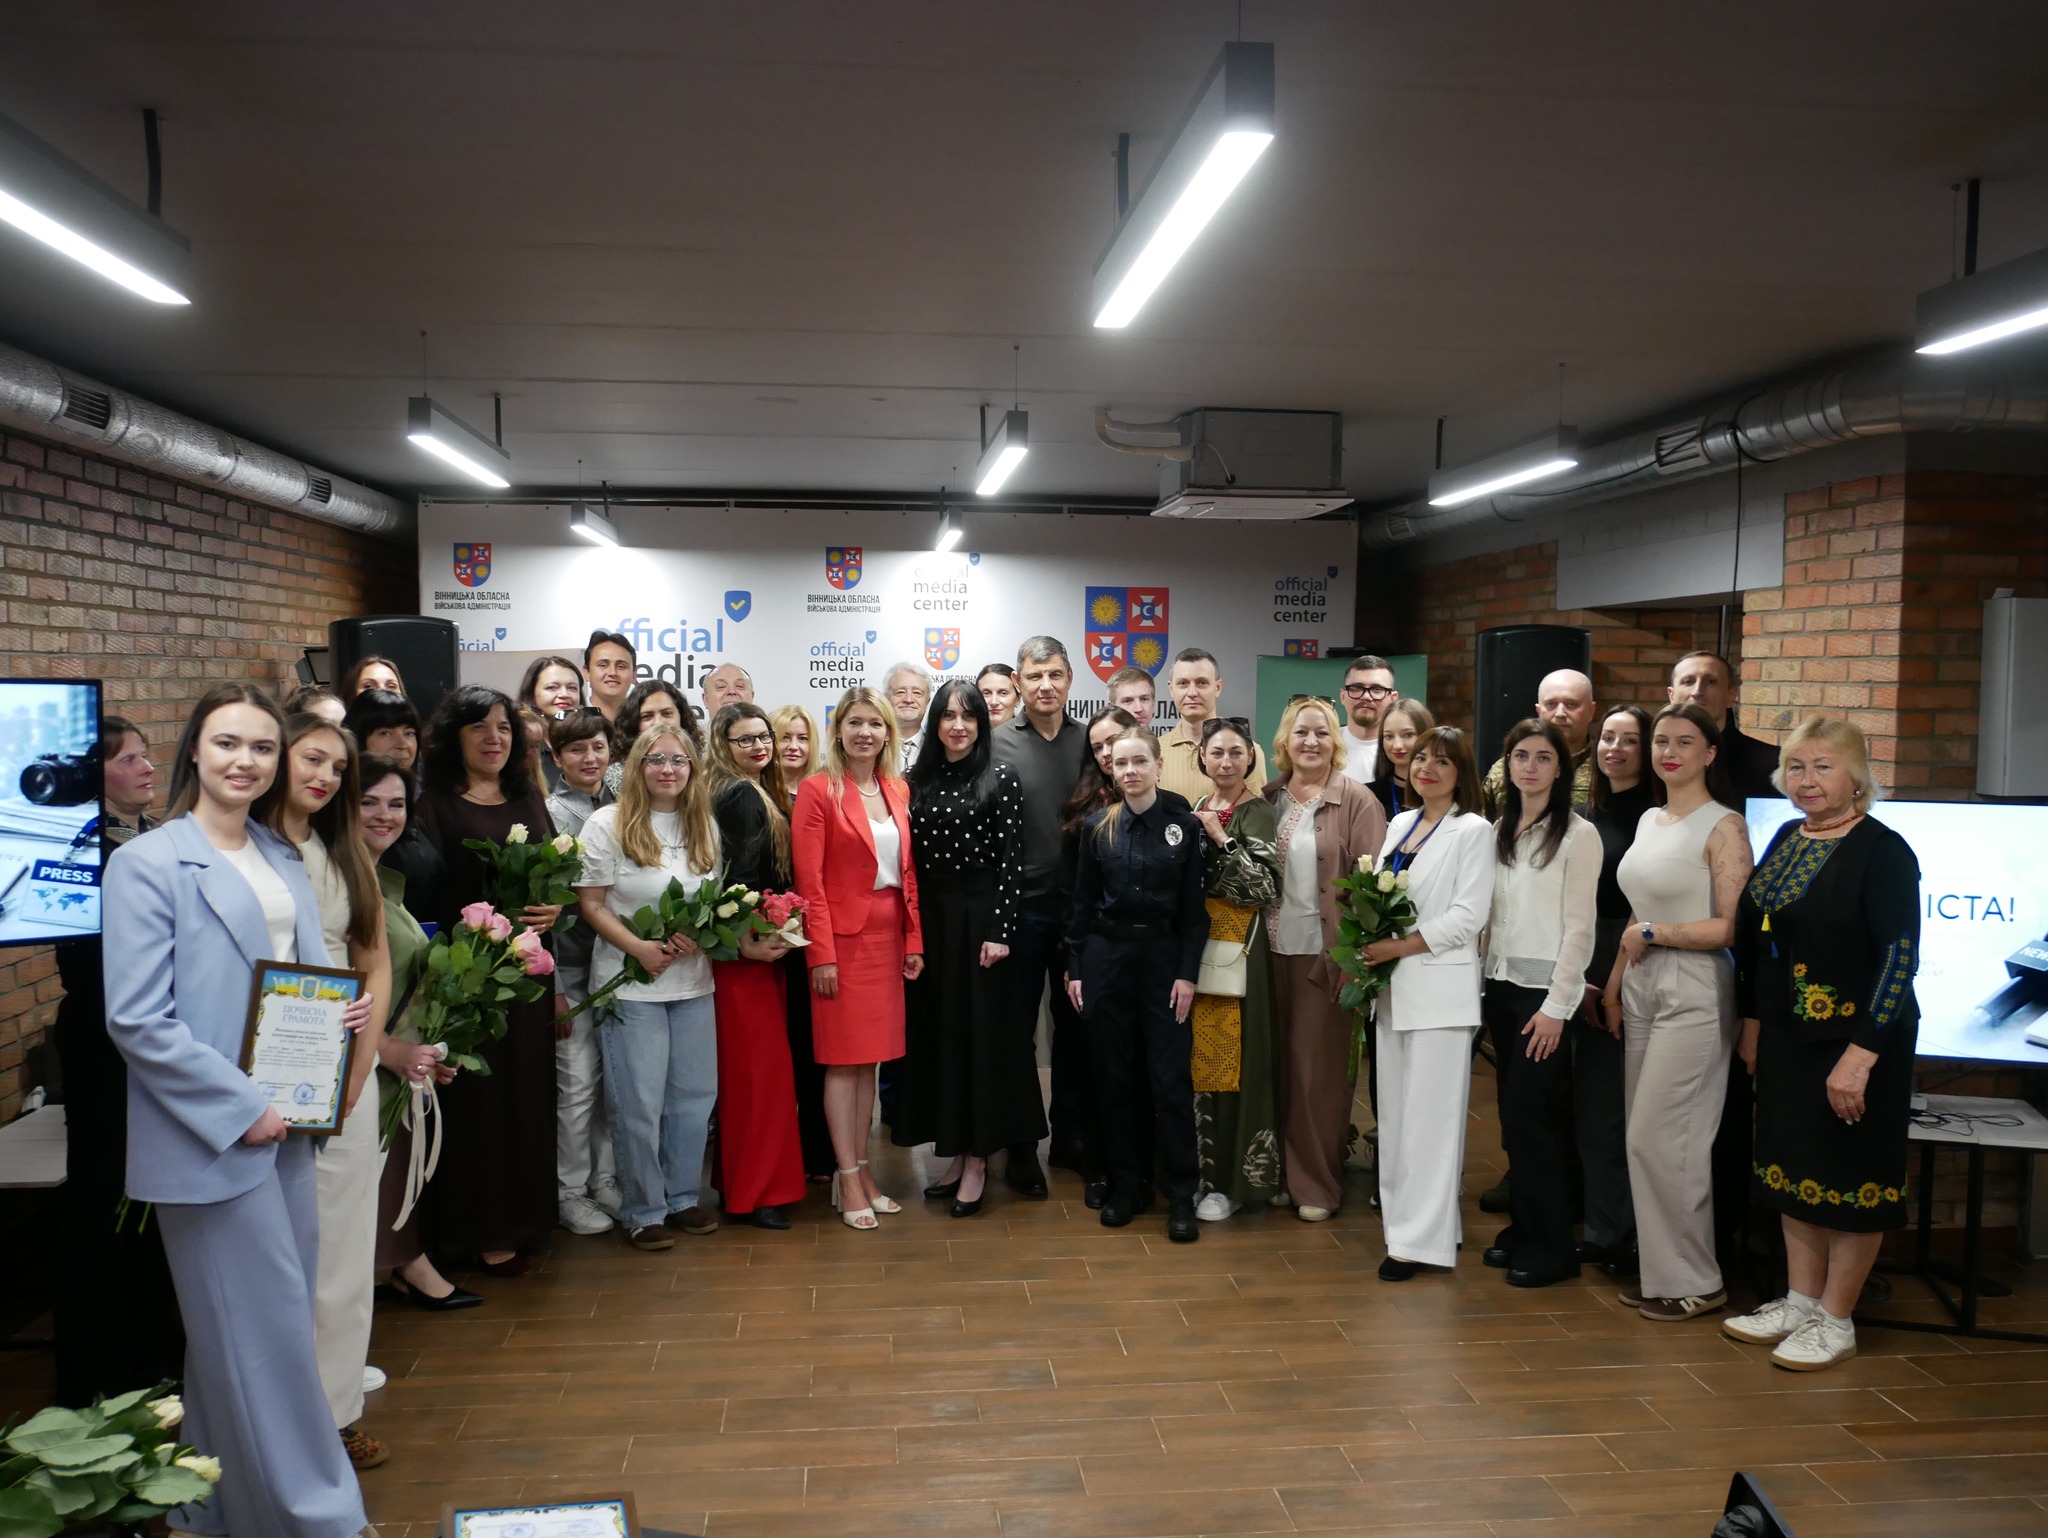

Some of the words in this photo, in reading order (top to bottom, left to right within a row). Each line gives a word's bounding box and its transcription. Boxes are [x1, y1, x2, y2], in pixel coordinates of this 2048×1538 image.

[914, 579, 967, 593] media
[1275, 577, 1327, 591] official
[434, 591, 475, 600] ВІННИЦЬКА
[477, 591, 510, 600] ОБЛАСНА
[807, 594, 846, 603] ВІННИЦЬКА
[847, 594, 880, 603] ОБЛАСНА
[1274, 591, 1325, 606] media
[913, 598, 968, 610] center
[1274, 610, 1327, 622] center
[591, 617, 723, 652] fficial
[810, 641, 865, 656] official
[810, 657, 864, 671] media
[809, 676, 865, 688] center
[40, 866, 93, 883] PRESS
[2019, 946, 2048, 962] NEW
[283, 1005, 327, 1017] ПОЧЕСНА
[282, 1014, 325, 1026] ГРАМОТА
